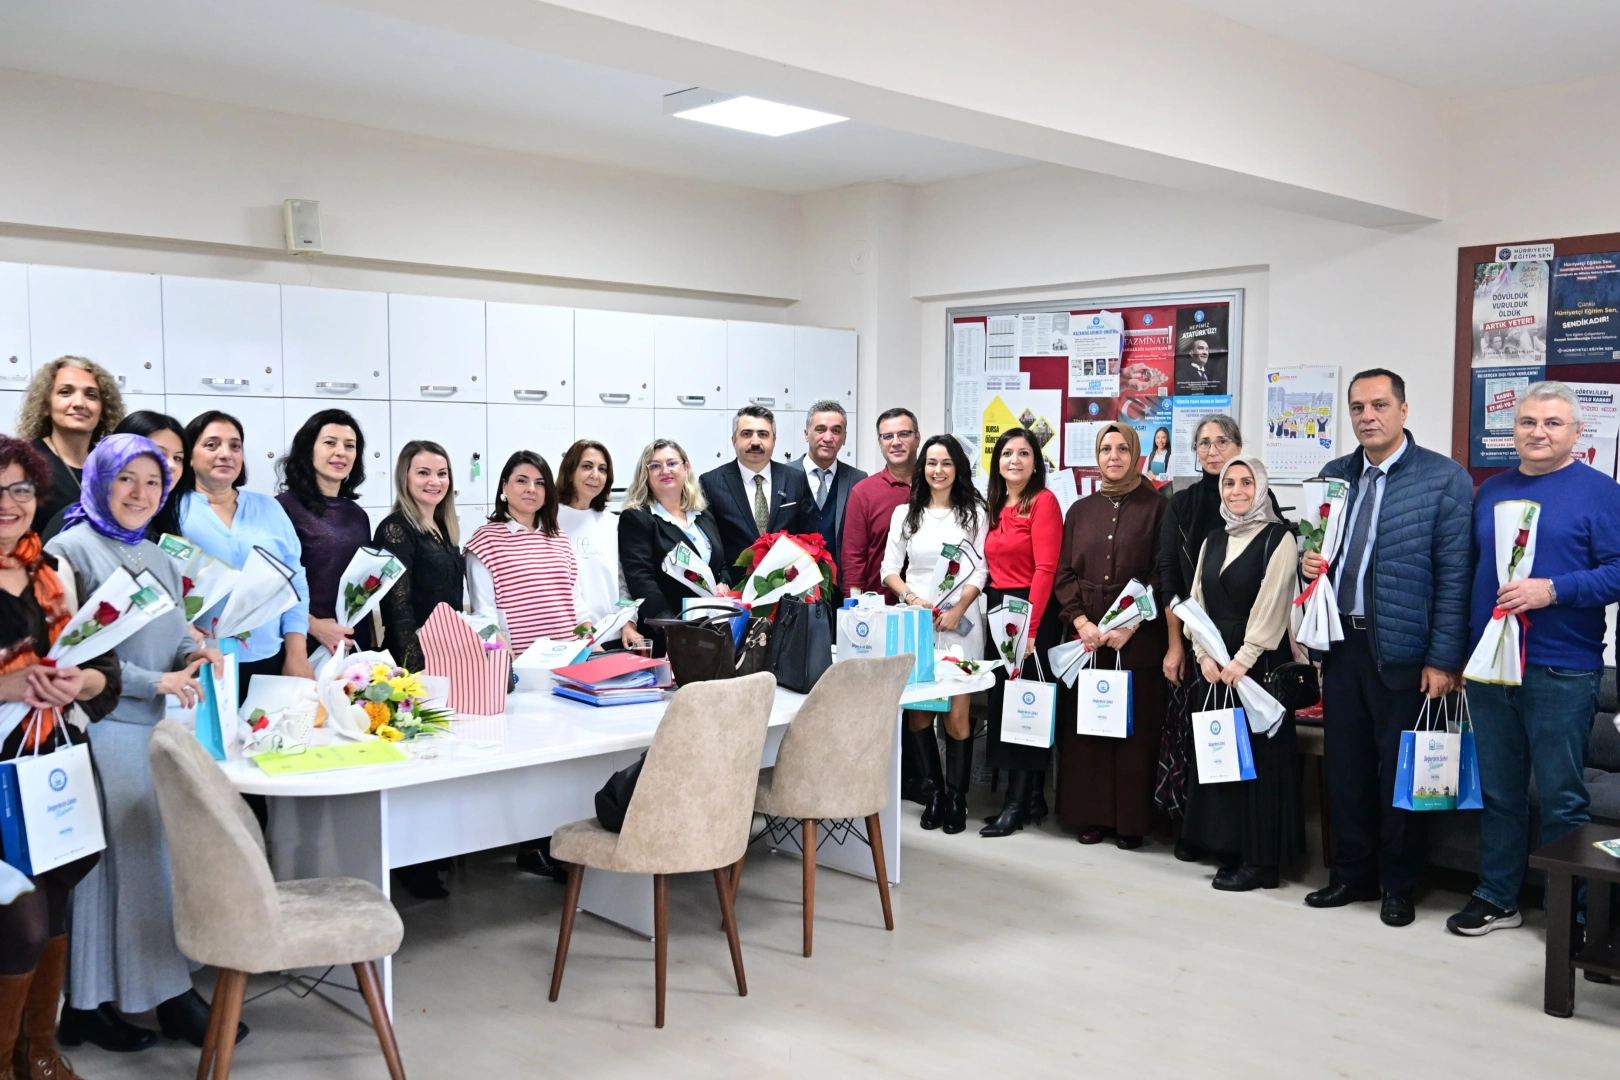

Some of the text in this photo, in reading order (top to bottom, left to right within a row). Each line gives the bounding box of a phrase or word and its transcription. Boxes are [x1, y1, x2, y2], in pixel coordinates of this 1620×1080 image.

[1492, 291, 1529, 301] DÖVÜLDÜK
[1492, 300, 1529, 310] VURULDUK
[1584, 308, 1604, 316] Eğitim
[1188, 322, 1210, 331] HEPİMİZ
[1485, 317, 1533, 331] ARTIK YETER!
[1562, 315, 1610, 329] SENDİKADIR!
[1182, 327, 1217, 339] ATATÜRK'ÜZ!
[1124, 334, 1169, 346] TAZMİNATI
[985, 425, 1000, 433] BURSA
